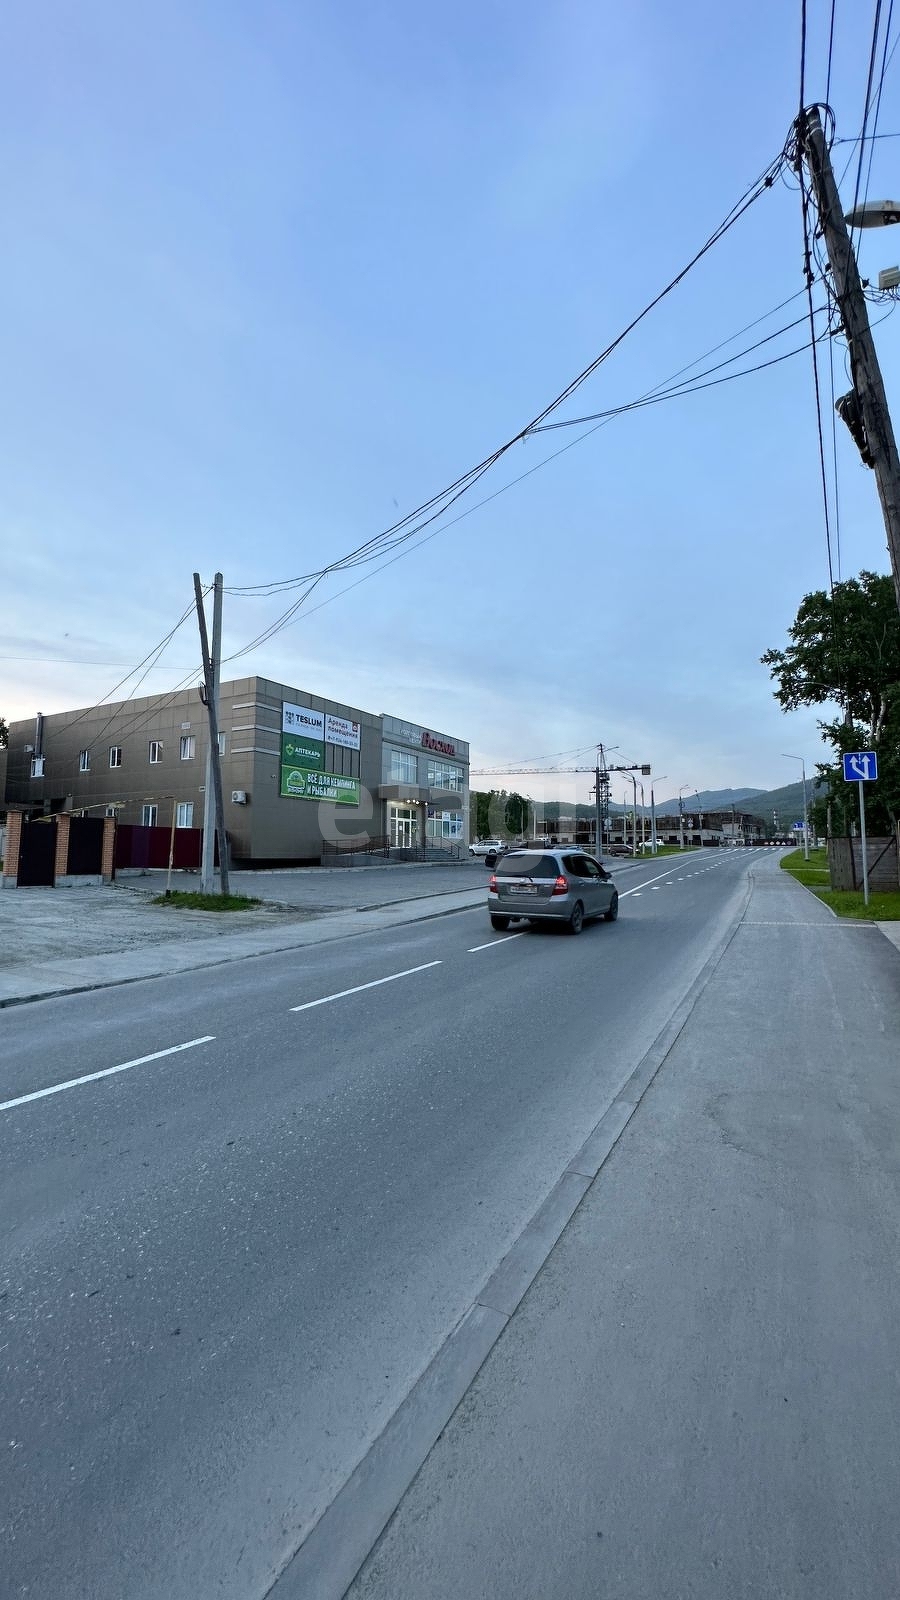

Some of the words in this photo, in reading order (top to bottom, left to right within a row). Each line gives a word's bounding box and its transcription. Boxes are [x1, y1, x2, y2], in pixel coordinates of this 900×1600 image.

[296, 714, 322, 727] TESLUM
[328, 718, 348, 729] Аренда
[318, 776, 331, 787] ДЛЯ
[312, 787, 337, 797] РЫБАЛКИ
